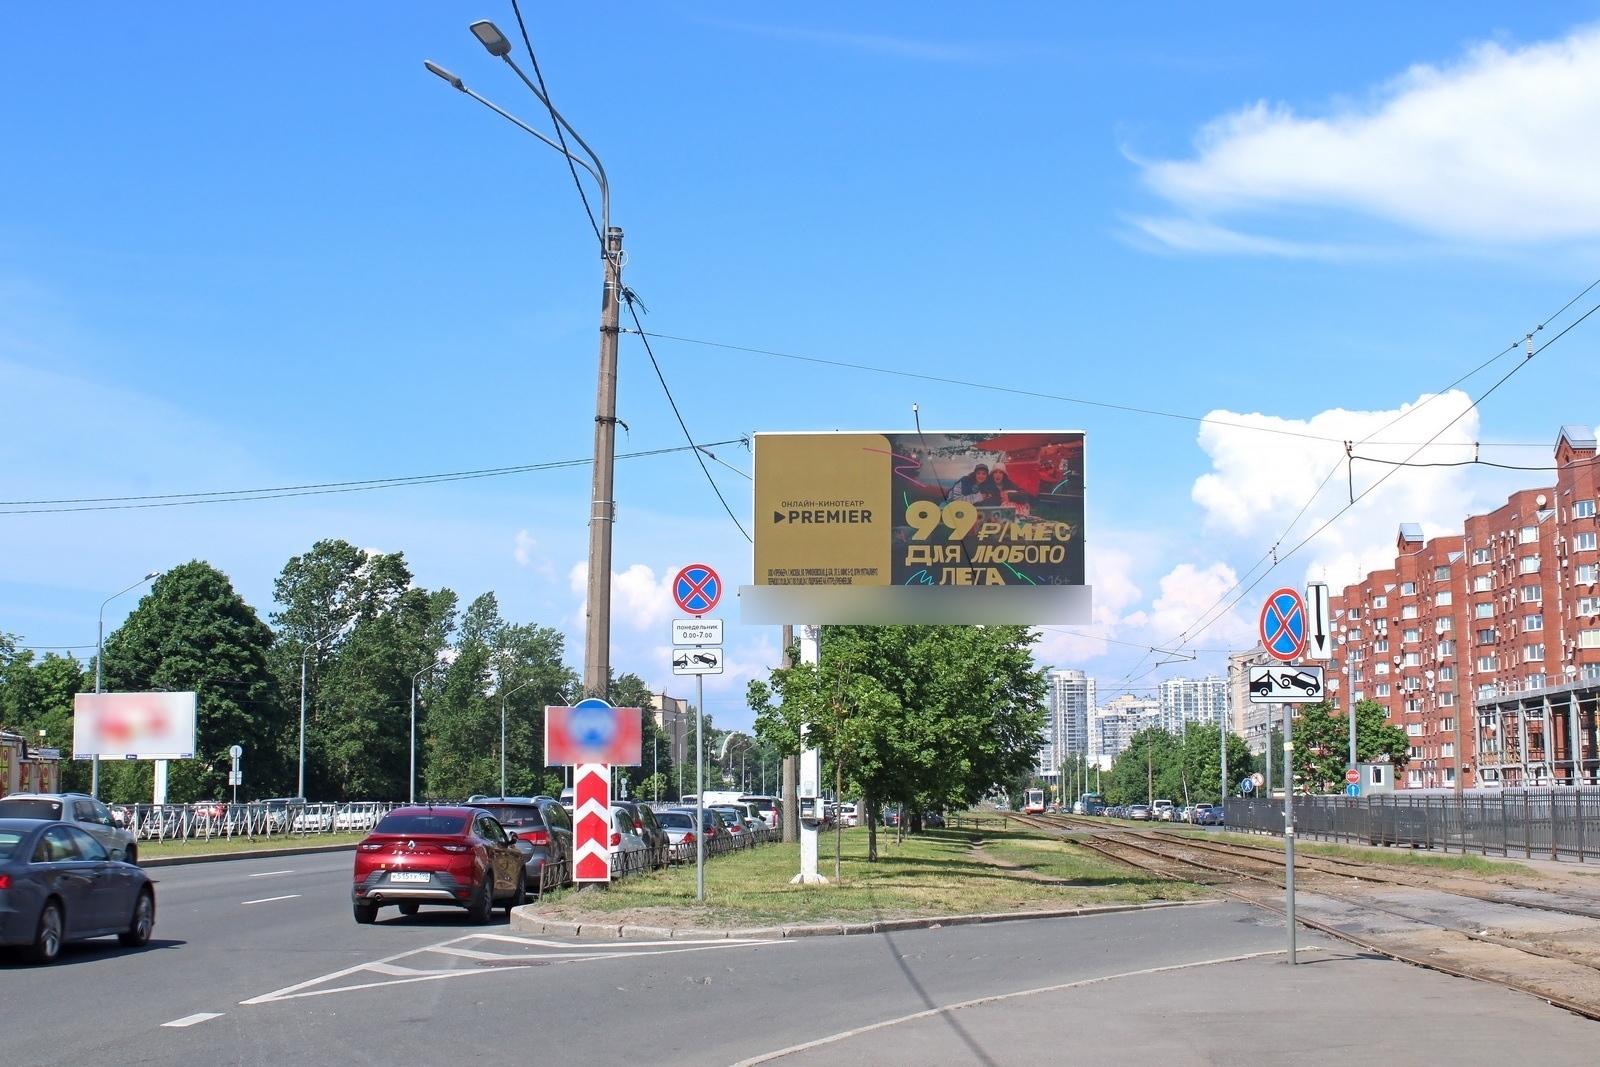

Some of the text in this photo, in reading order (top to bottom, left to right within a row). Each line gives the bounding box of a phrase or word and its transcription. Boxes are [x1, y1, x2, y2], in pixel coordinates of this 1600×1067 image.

[781, 500, 865, 508] ОНЛАЙН-КИНОТЕАТР
[788, 510, 873, 524] PREMIER
[905, 500, 978, 541] 99
[905, 545, 1066, 566] ДЛЯ ЛЮБОГО
[939, 567, 1007, 585] ЛЕТА
